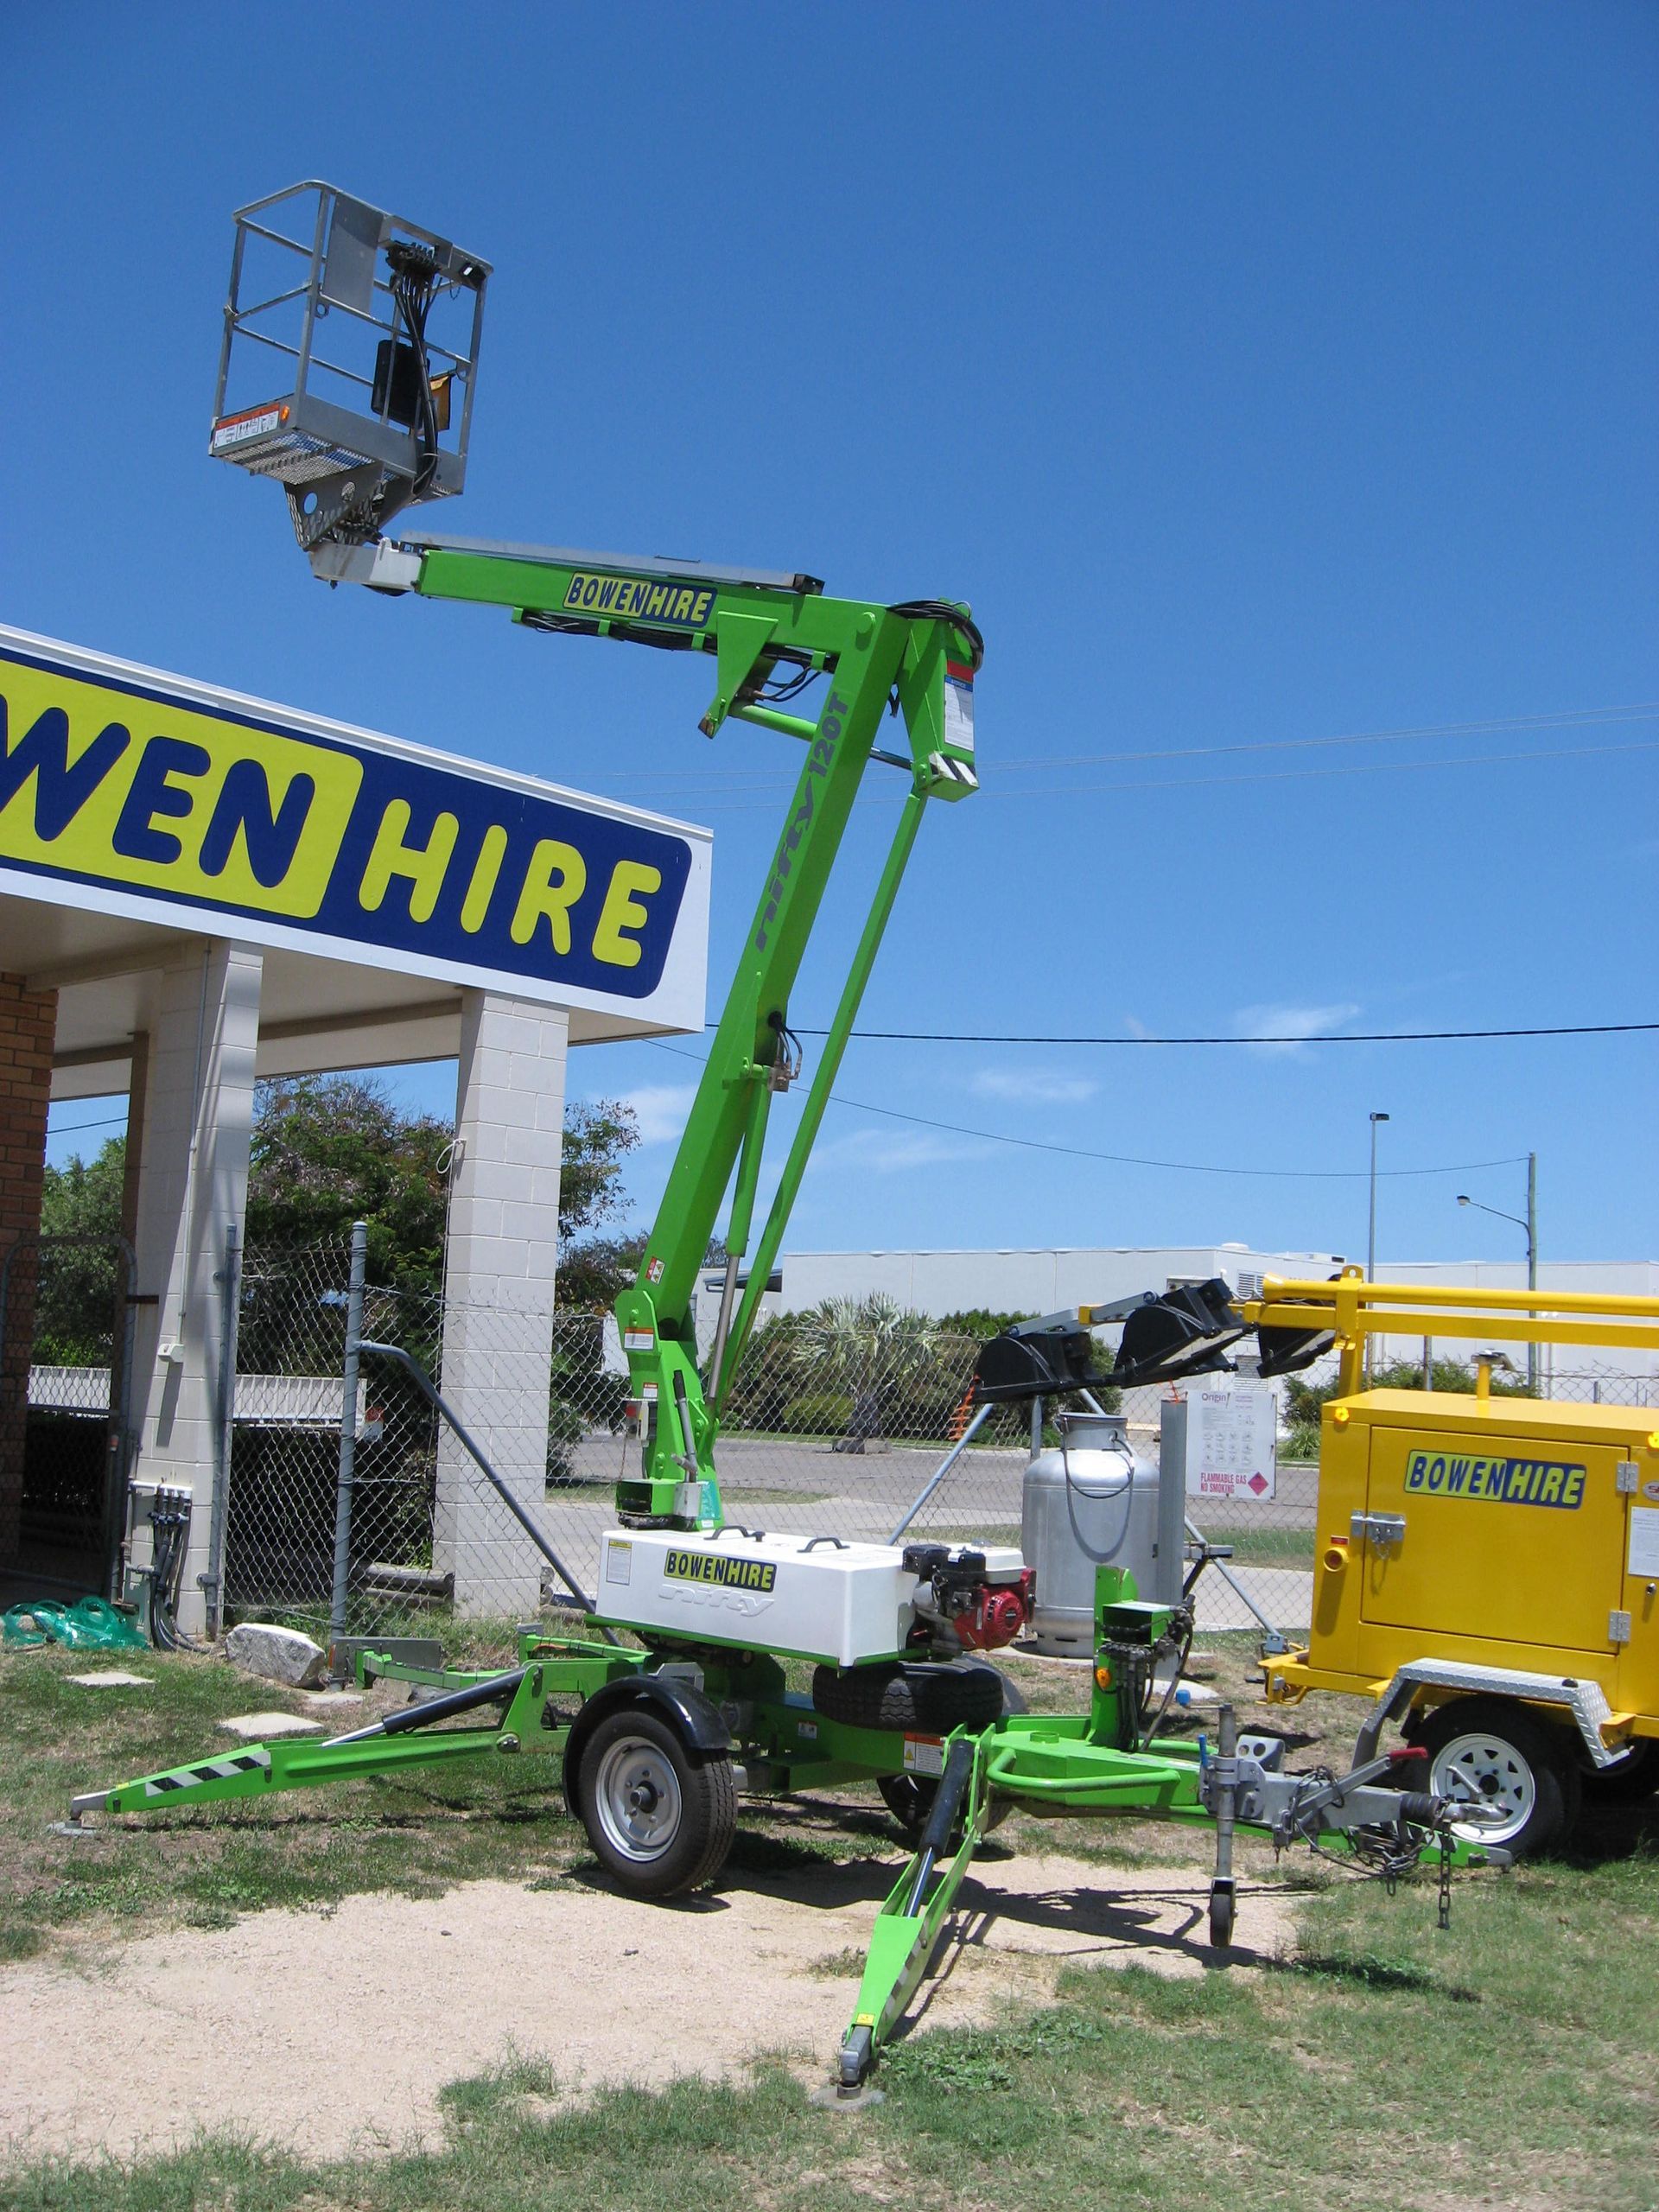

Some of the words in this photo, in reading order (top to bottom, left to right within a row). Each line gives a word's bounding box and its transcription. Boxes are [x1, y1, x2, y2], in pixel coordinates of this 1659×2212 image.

[807, 691, 849, 779] 120T
[0, 693, 316, 888] WEN
[358, 781, 663, 968] HIRE
[1200, 1471, 1235, 1484] FLAMMABLE
[1235, 1474, 1247, 1485] GAS
[1200, 1482, 1209, 1492] NO
[1209, 1483, 1236, 1494] SMOKING
[658, 1582, 776, 1618] nifty
